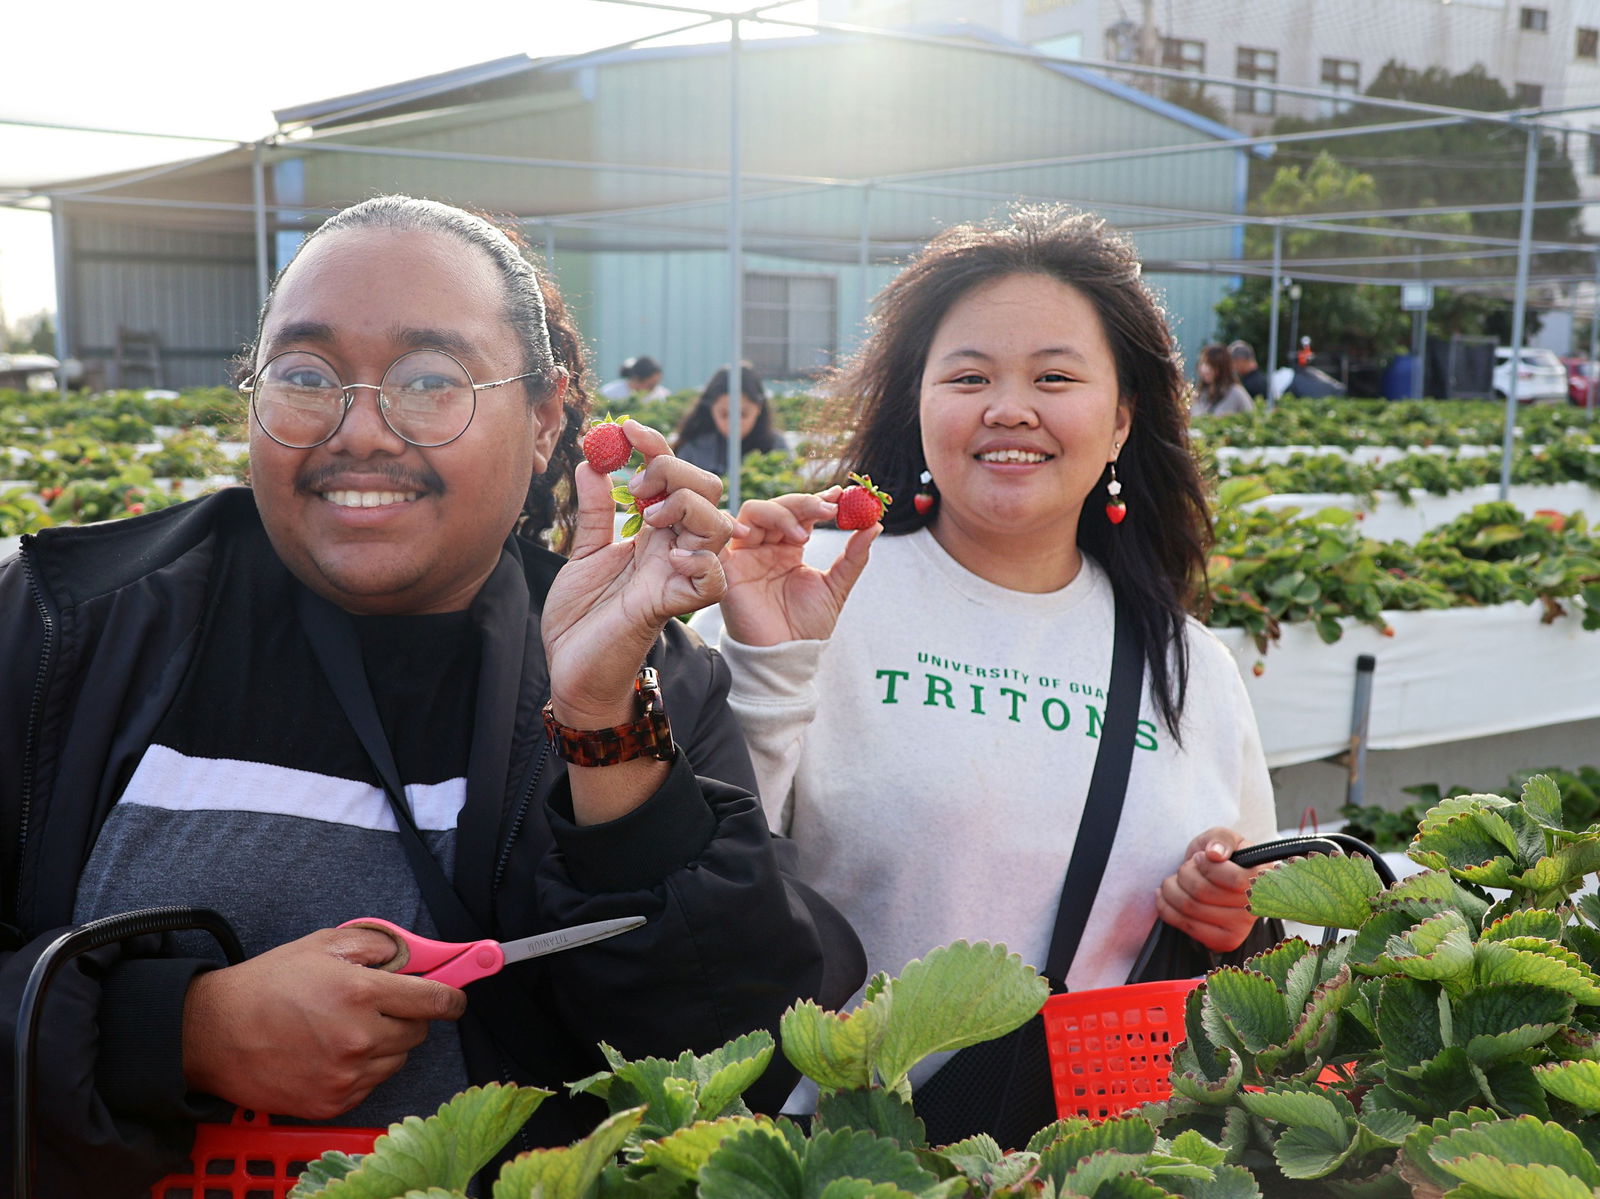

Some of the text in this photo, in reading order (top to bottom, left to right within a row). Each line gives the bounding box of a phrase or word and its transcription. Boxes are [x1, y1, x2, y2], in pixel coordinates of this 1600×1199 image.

[918, 652, 1109, 700] UNIVERSITY OF GUA
[527, 933, 569, 952] TITANIUM
